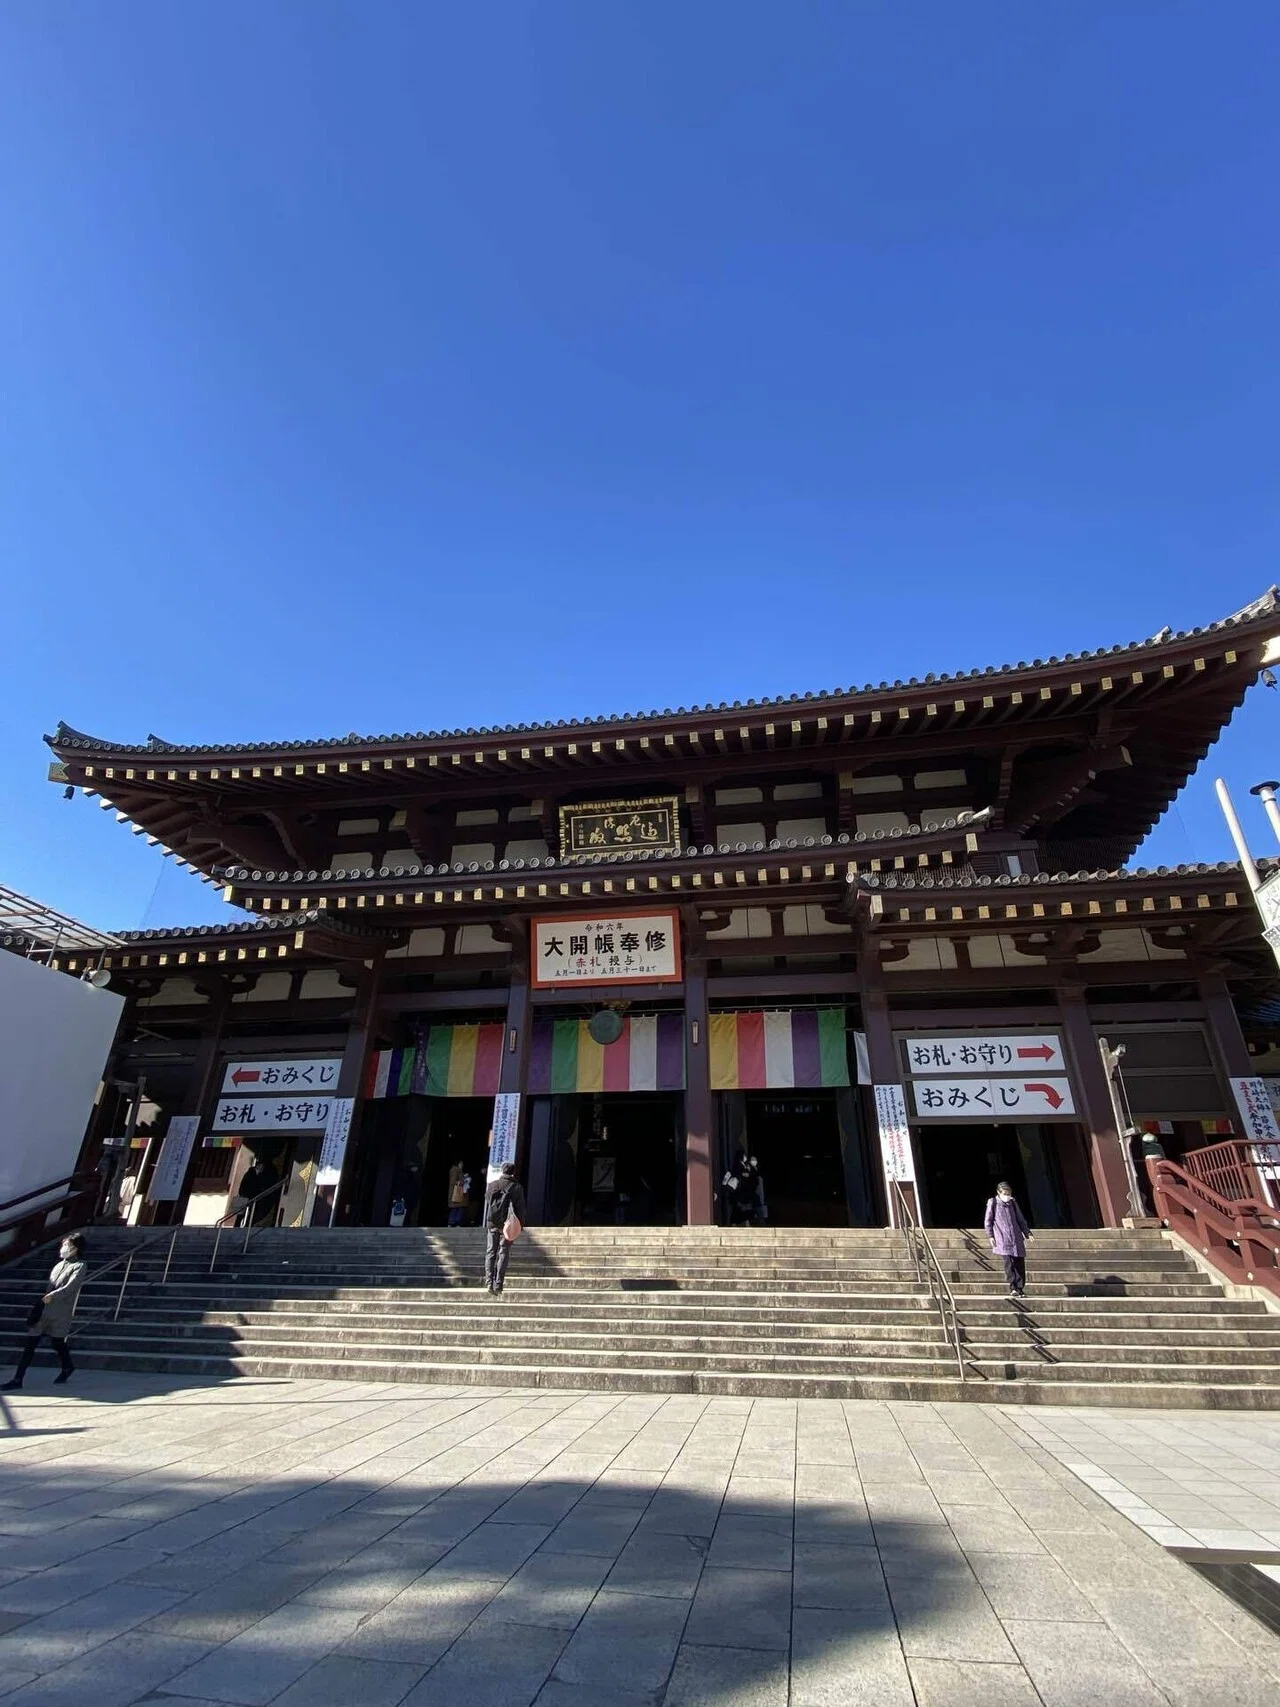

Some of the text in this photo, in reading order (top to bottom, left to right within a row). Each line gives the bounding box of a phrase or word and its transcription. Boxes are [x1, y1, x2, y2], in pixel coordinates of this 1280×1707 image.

[585, 922, 624, 933] 令和六年
[544, 930, 667, 957] 大開帳奉修
[913, 1043, 1012, 1066] お札・お守り
[262, 1065, 334, 1084] おみくじ
[922, 1086, 1020, 1108] おみくじ
[220, 1102, 329, 1123] お札・お守り
